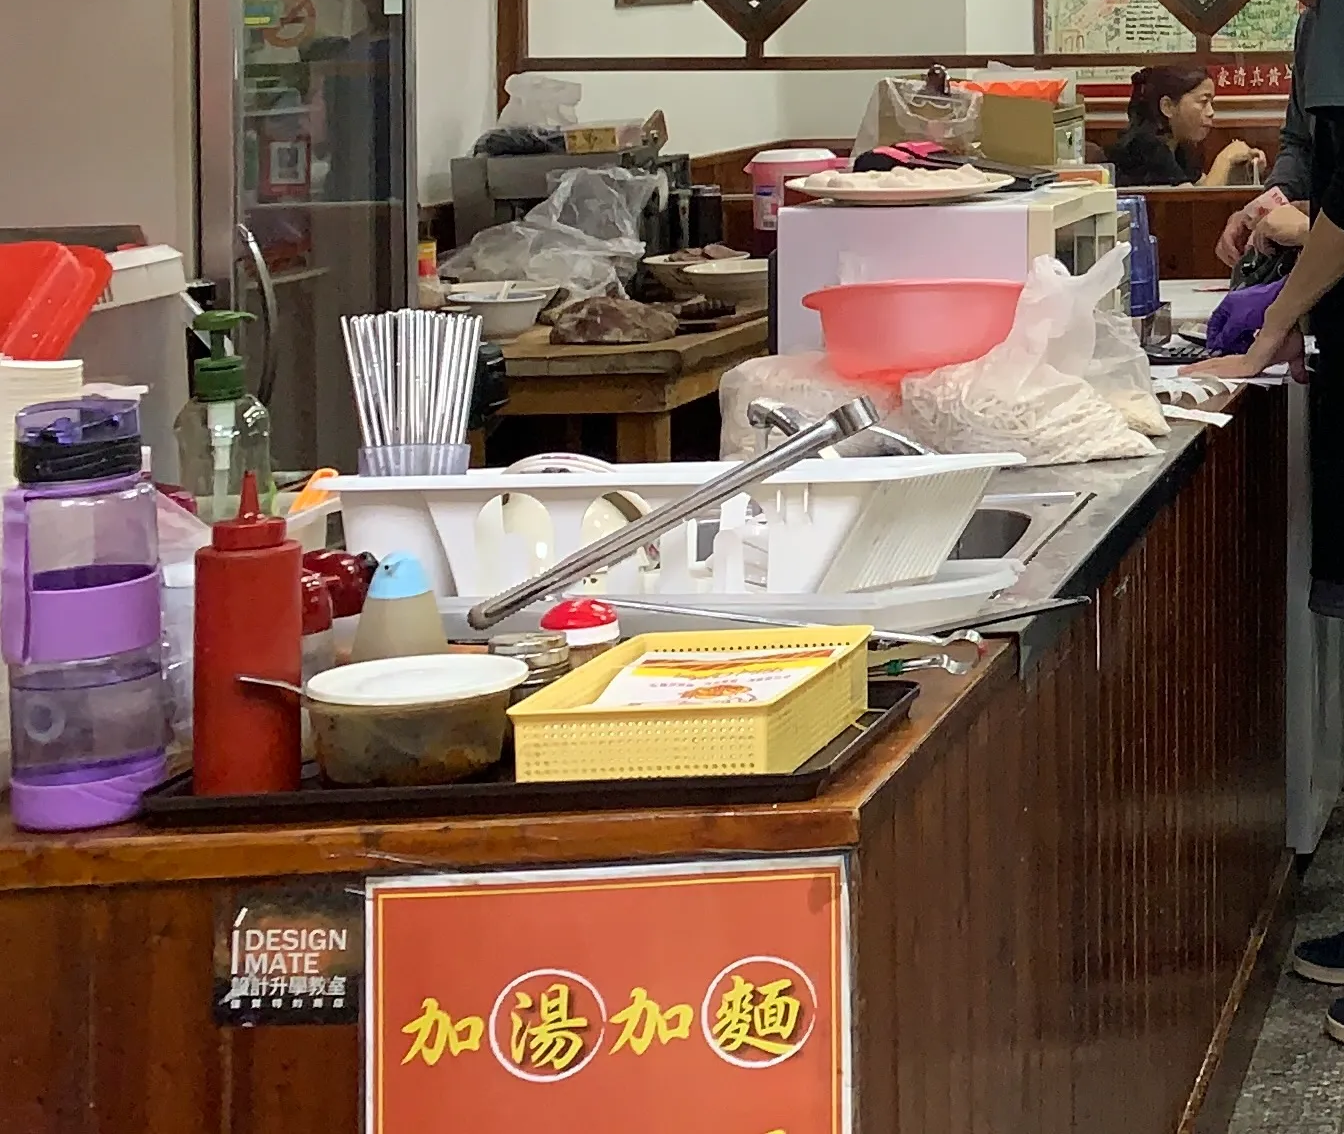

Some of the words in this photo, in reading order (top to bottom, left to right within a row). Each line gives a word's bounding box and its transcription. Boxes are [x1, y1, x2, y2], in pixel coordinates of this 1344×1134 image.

[245, 929, 347, 951] DESIGN
[244, 953, 320, 975] MATE
[401, 975, 801, 1071] 加湯加麵
